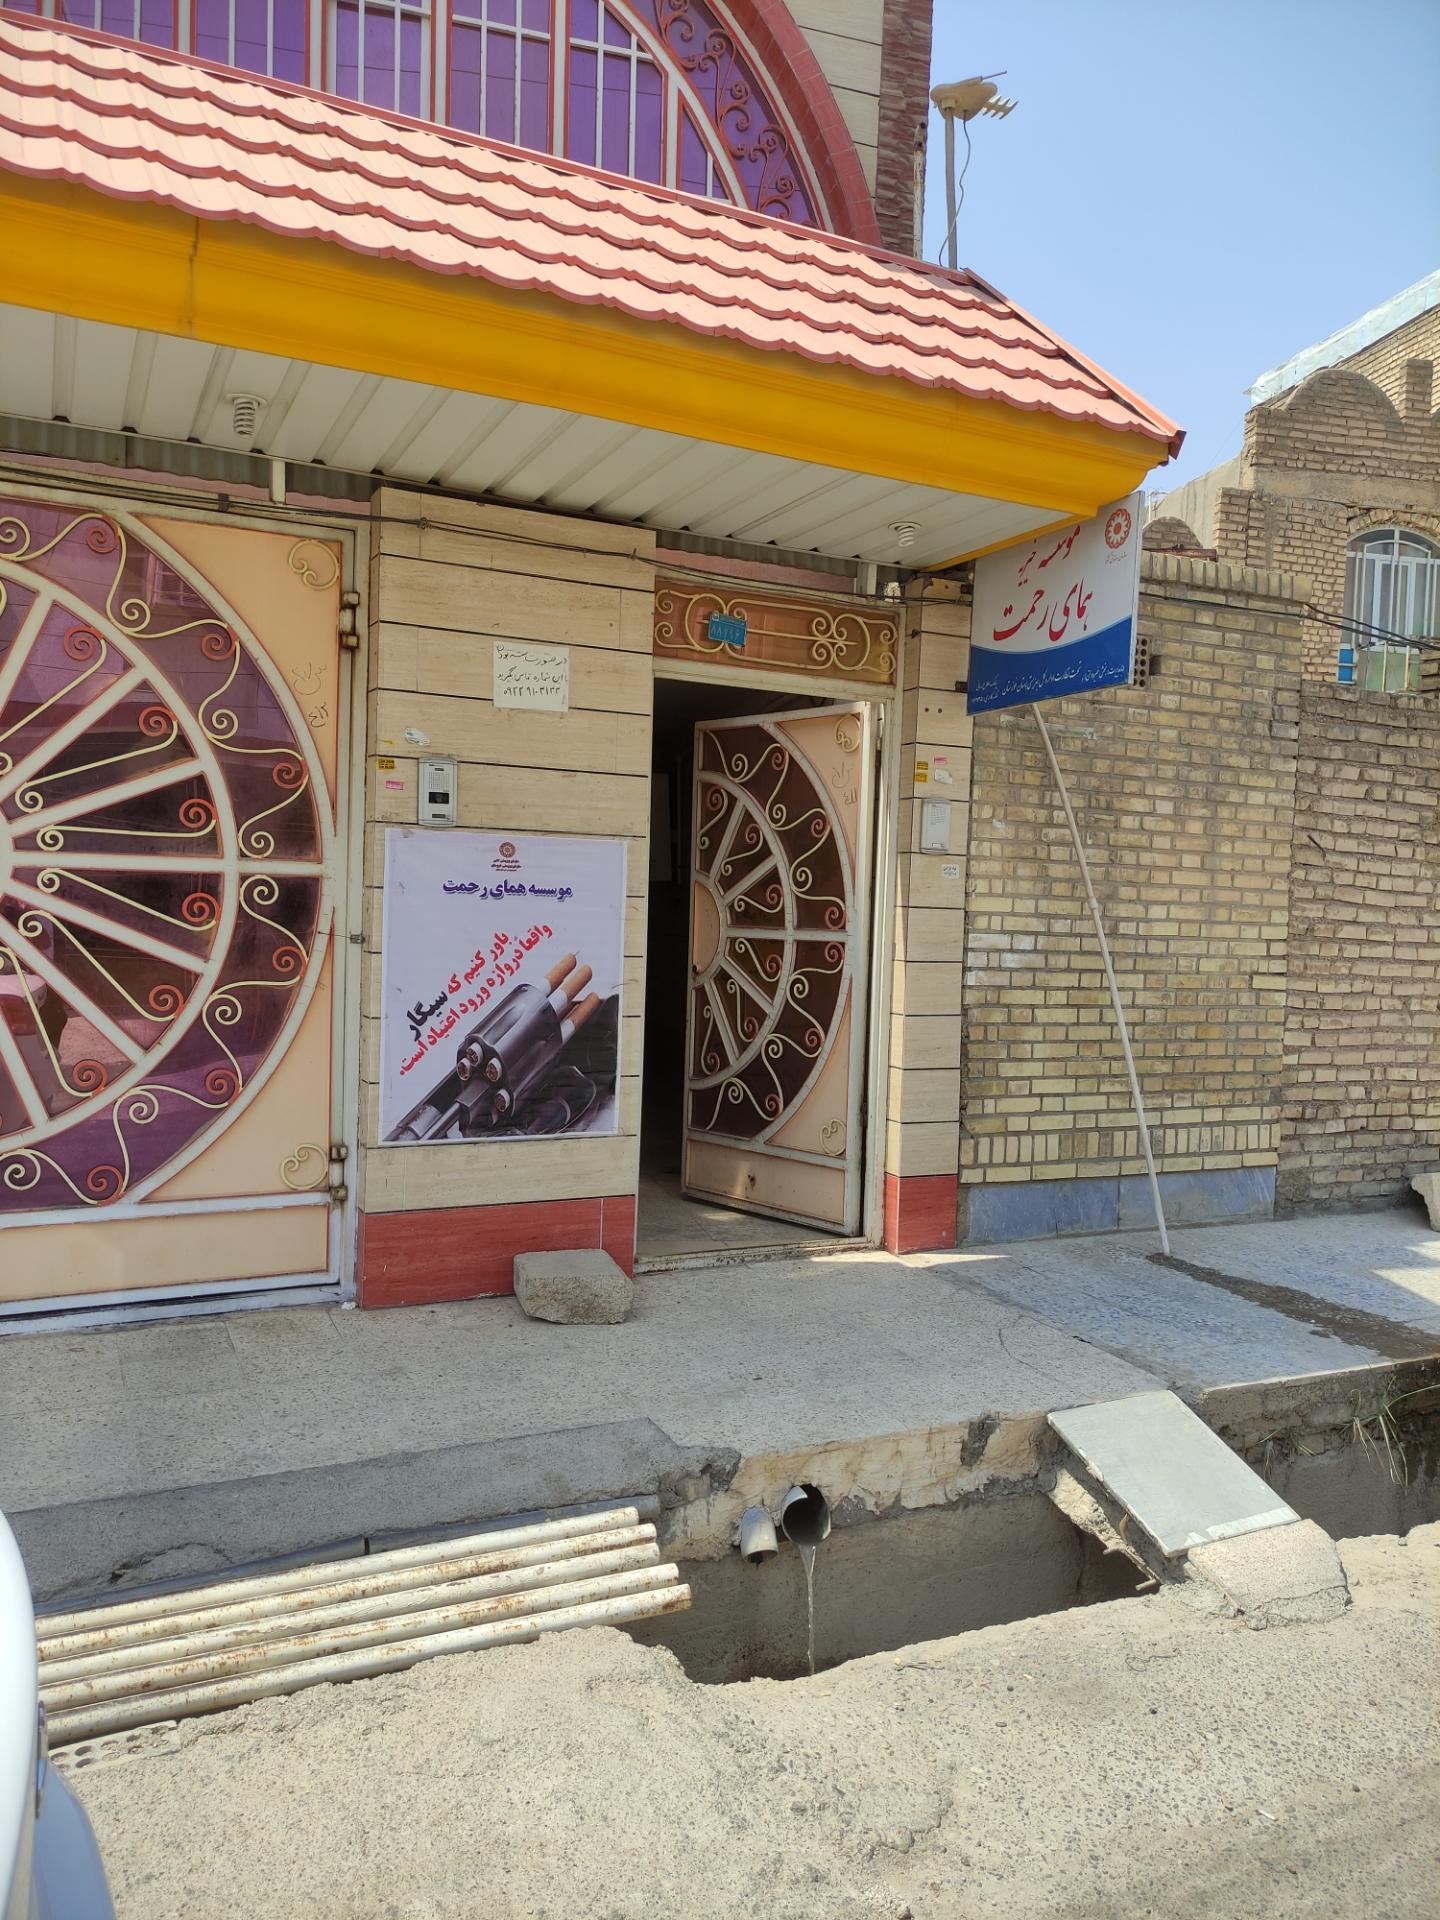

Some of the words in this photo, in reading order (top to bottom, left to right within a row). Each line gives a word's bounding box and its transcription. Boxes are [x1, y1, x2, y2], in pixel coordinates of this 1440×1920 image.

[993, 589, 1049, 642] رحمت
[1049, 578, 1093, 642] همای
[442, 880, 489, 900] رحمت
[489, 879, 528, 900] همای
[528, 884, 573, 902] موسسه
[490, 932, 512, 962] باور
[463, 949, 486, 985] کنیم
[486, 949, 525, 987] دروازه
[447, 973, 462, 995] که
[458, 986, 492, 1012] ورود
[406, 990, 449, 1042] سیگار
[426, 1007, 461, 1047] اعتیاد
